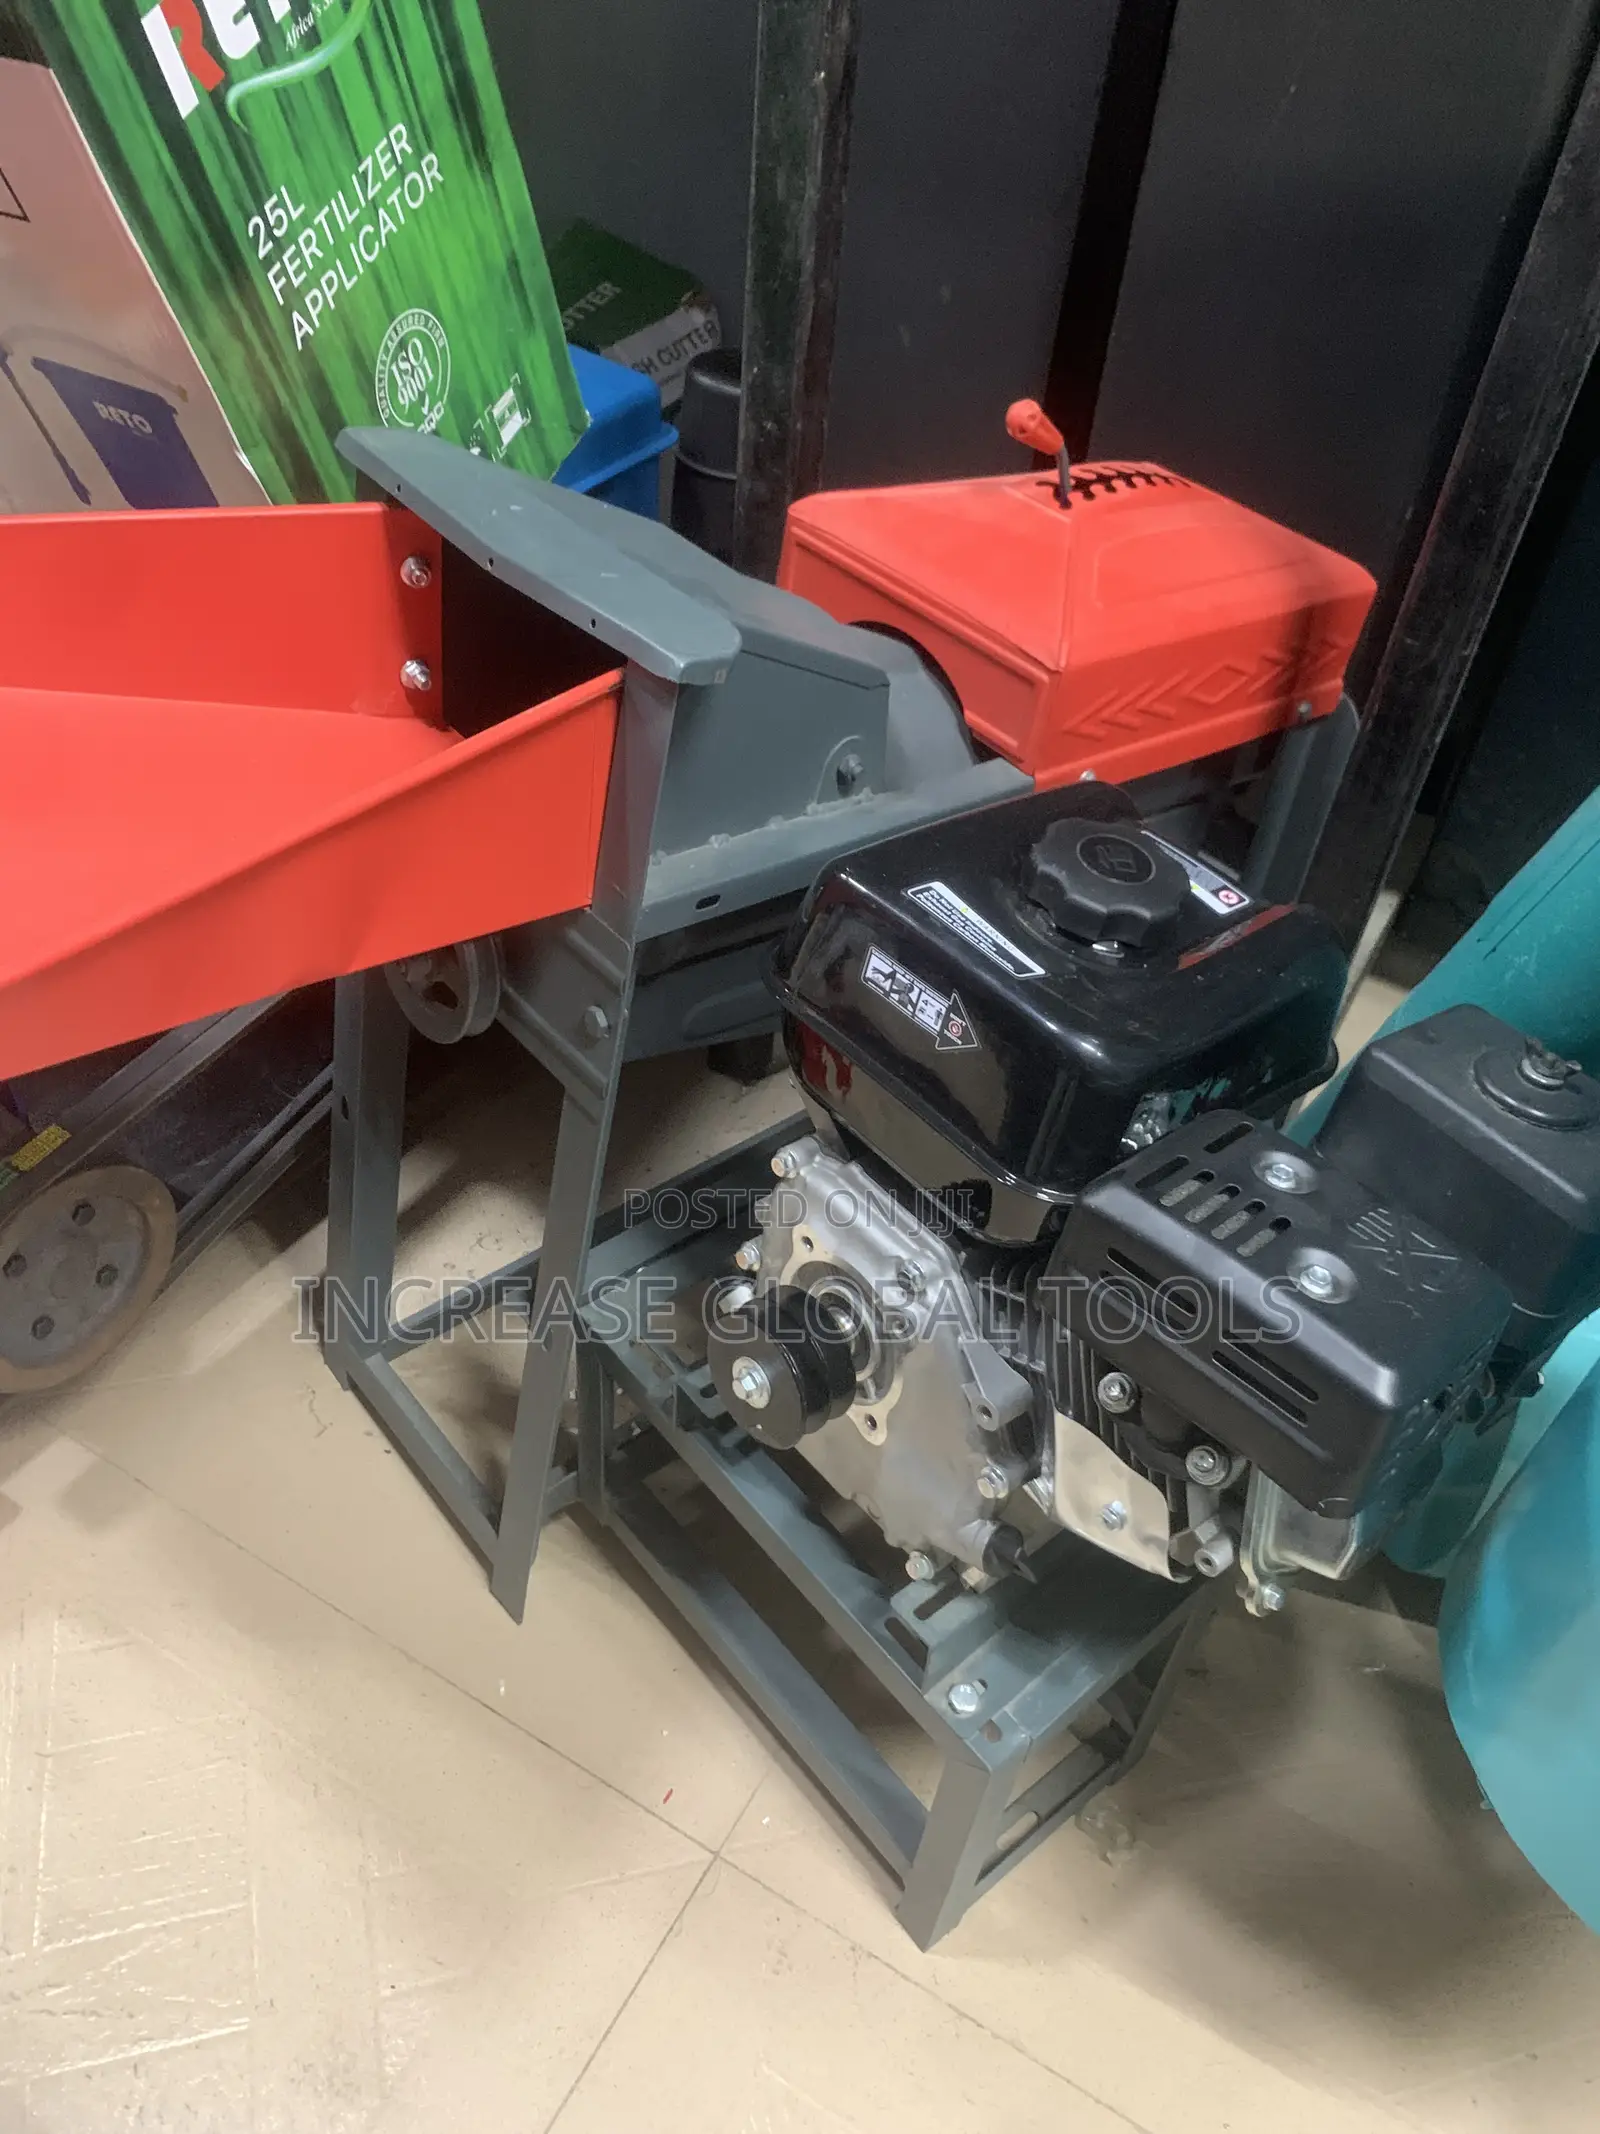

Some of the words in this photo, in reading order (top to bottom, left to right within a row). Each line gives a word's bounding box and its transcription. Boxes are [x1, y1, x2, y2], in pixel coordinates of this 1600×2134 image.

[248, 185, 305, 260] 25L
[267, 122, 413, 306] FERTILIZER
[292, 152, 444, 352] APPLICATOR
[390, 337, 424, 386] ISO
[656, 319, 718, 367] CUTTER
[397, 356, 434, 415] 9001
[92, 401, 153, 434] RETO
